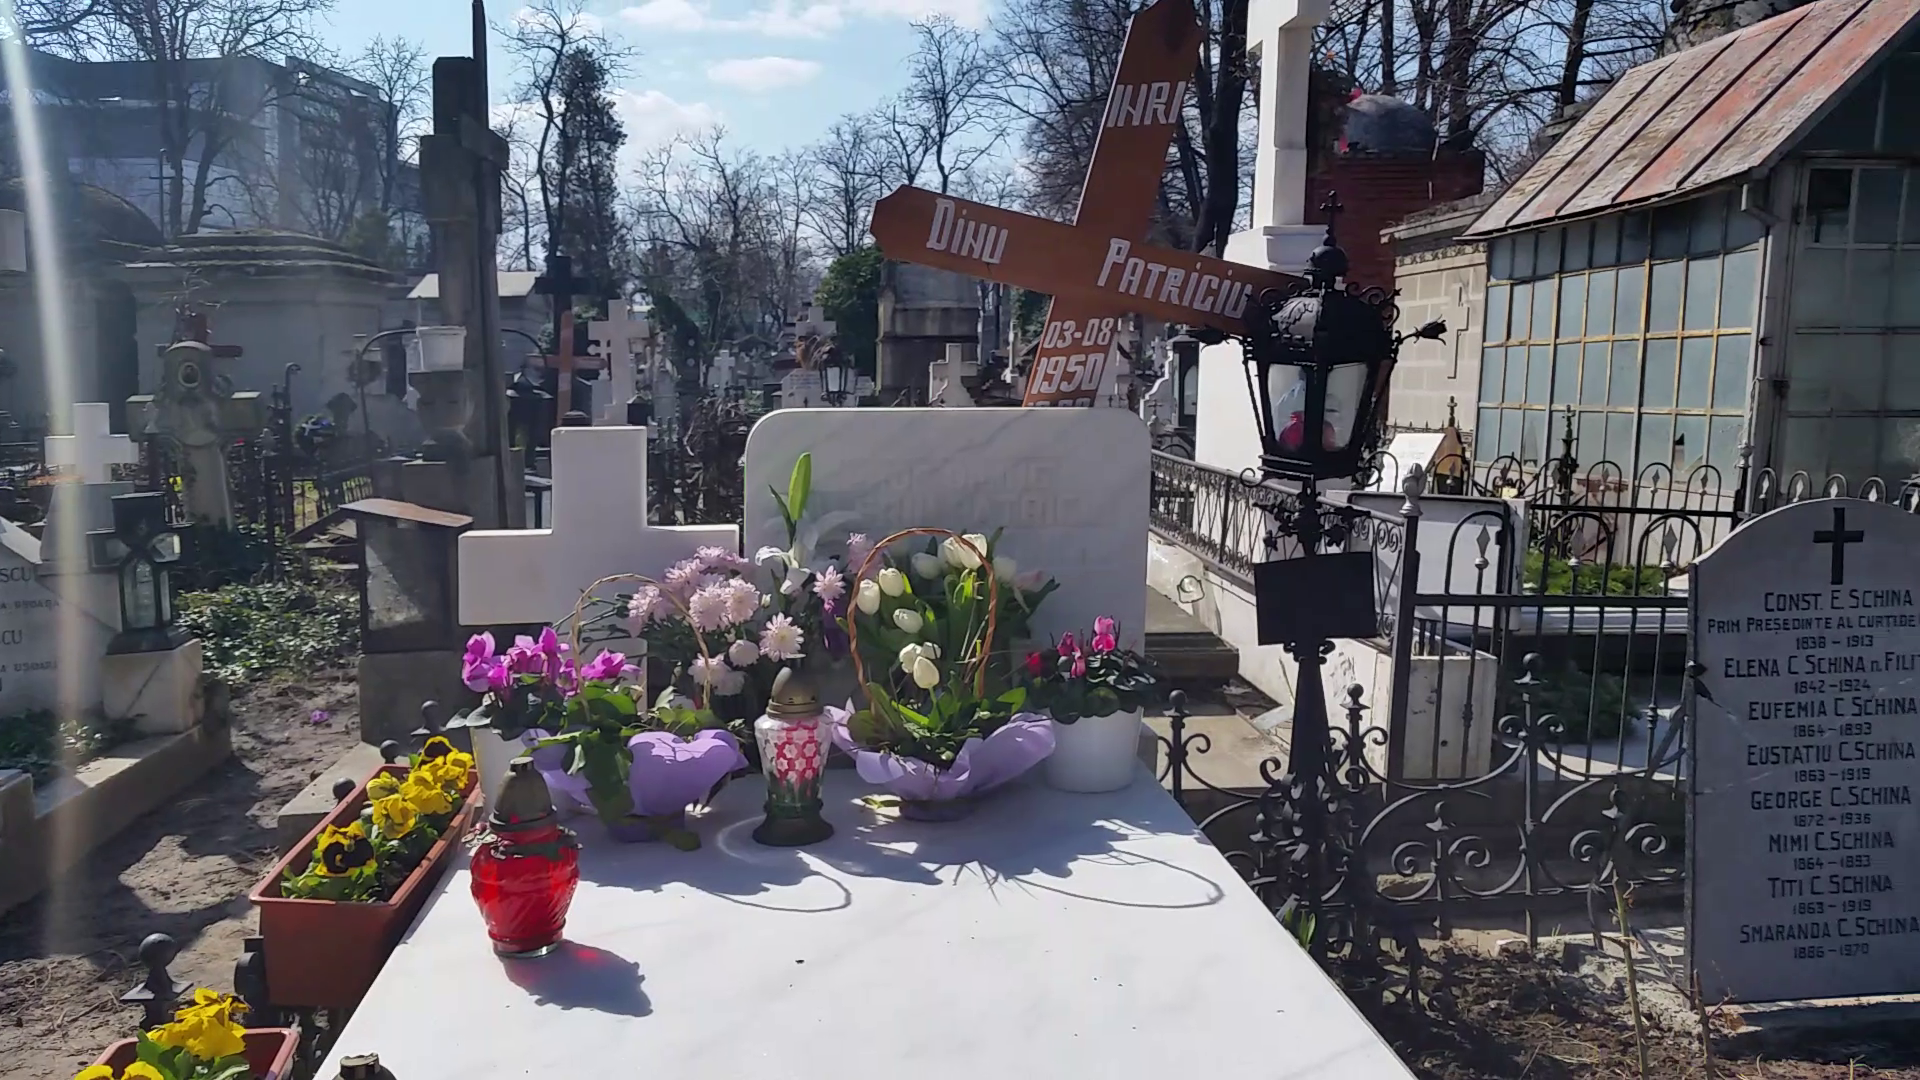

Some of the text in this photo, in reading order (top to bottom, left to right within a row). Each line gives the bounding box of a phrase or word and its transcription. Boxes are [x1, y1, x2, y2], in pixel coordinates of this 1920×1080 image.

[1043, 317, 1114, 349] 03-08
[1031, 352, 1105, 395] 1950
[1764, 591, 1824, 613] CONST.
[1848, 587, 1914, 610] SCHINA
[1707, 618, 1740, 634] PRIM
[1837, 615, 1854, 630] AL
[1796, 635, 1826, 651] 1838
[1846, 633, 1874, 648] 1913
[1724, 657, 1781, 678] ELENA
[1804, 654, 1867, 675] SCHINA
[1794, 679, 1826, 695] 1842
[1839, 677, 1872, 693] 1924
[1748, 700, 1828, 721] EUFEMIA
[1851, 696, 1918, 717] SCHINA
[1794, 723, 1825, 738] 1864
[1747, 744, 1832, 767] EUSTATIU
[1854, 740, 1916, 762] SCHINA
[1795, 769, 1825, 783] 1863
[1841, 767, 1871, 781] 1919
[1751, 790, 1823, 811] GEORGE
[1848, 785, 1912, 806] SCHINA
[1794, 813, 1824, 828] 1872
[1769, 833, 1809, 853] MIMI
[1829, 830, 1895, 851] SCHINA
[1794, 857, 1824, 871] 1864
[1767, 876, 1804, 899] TITI
[1828, 874, 1894, 895] SCHINA
[1793, 901, 1825, 916] 1863
[1841, 899, 1872, 913] 1919
[1739, 922, 1832, 944] SMARANDA
[1855, 916, 1920, 937] SCHINA
